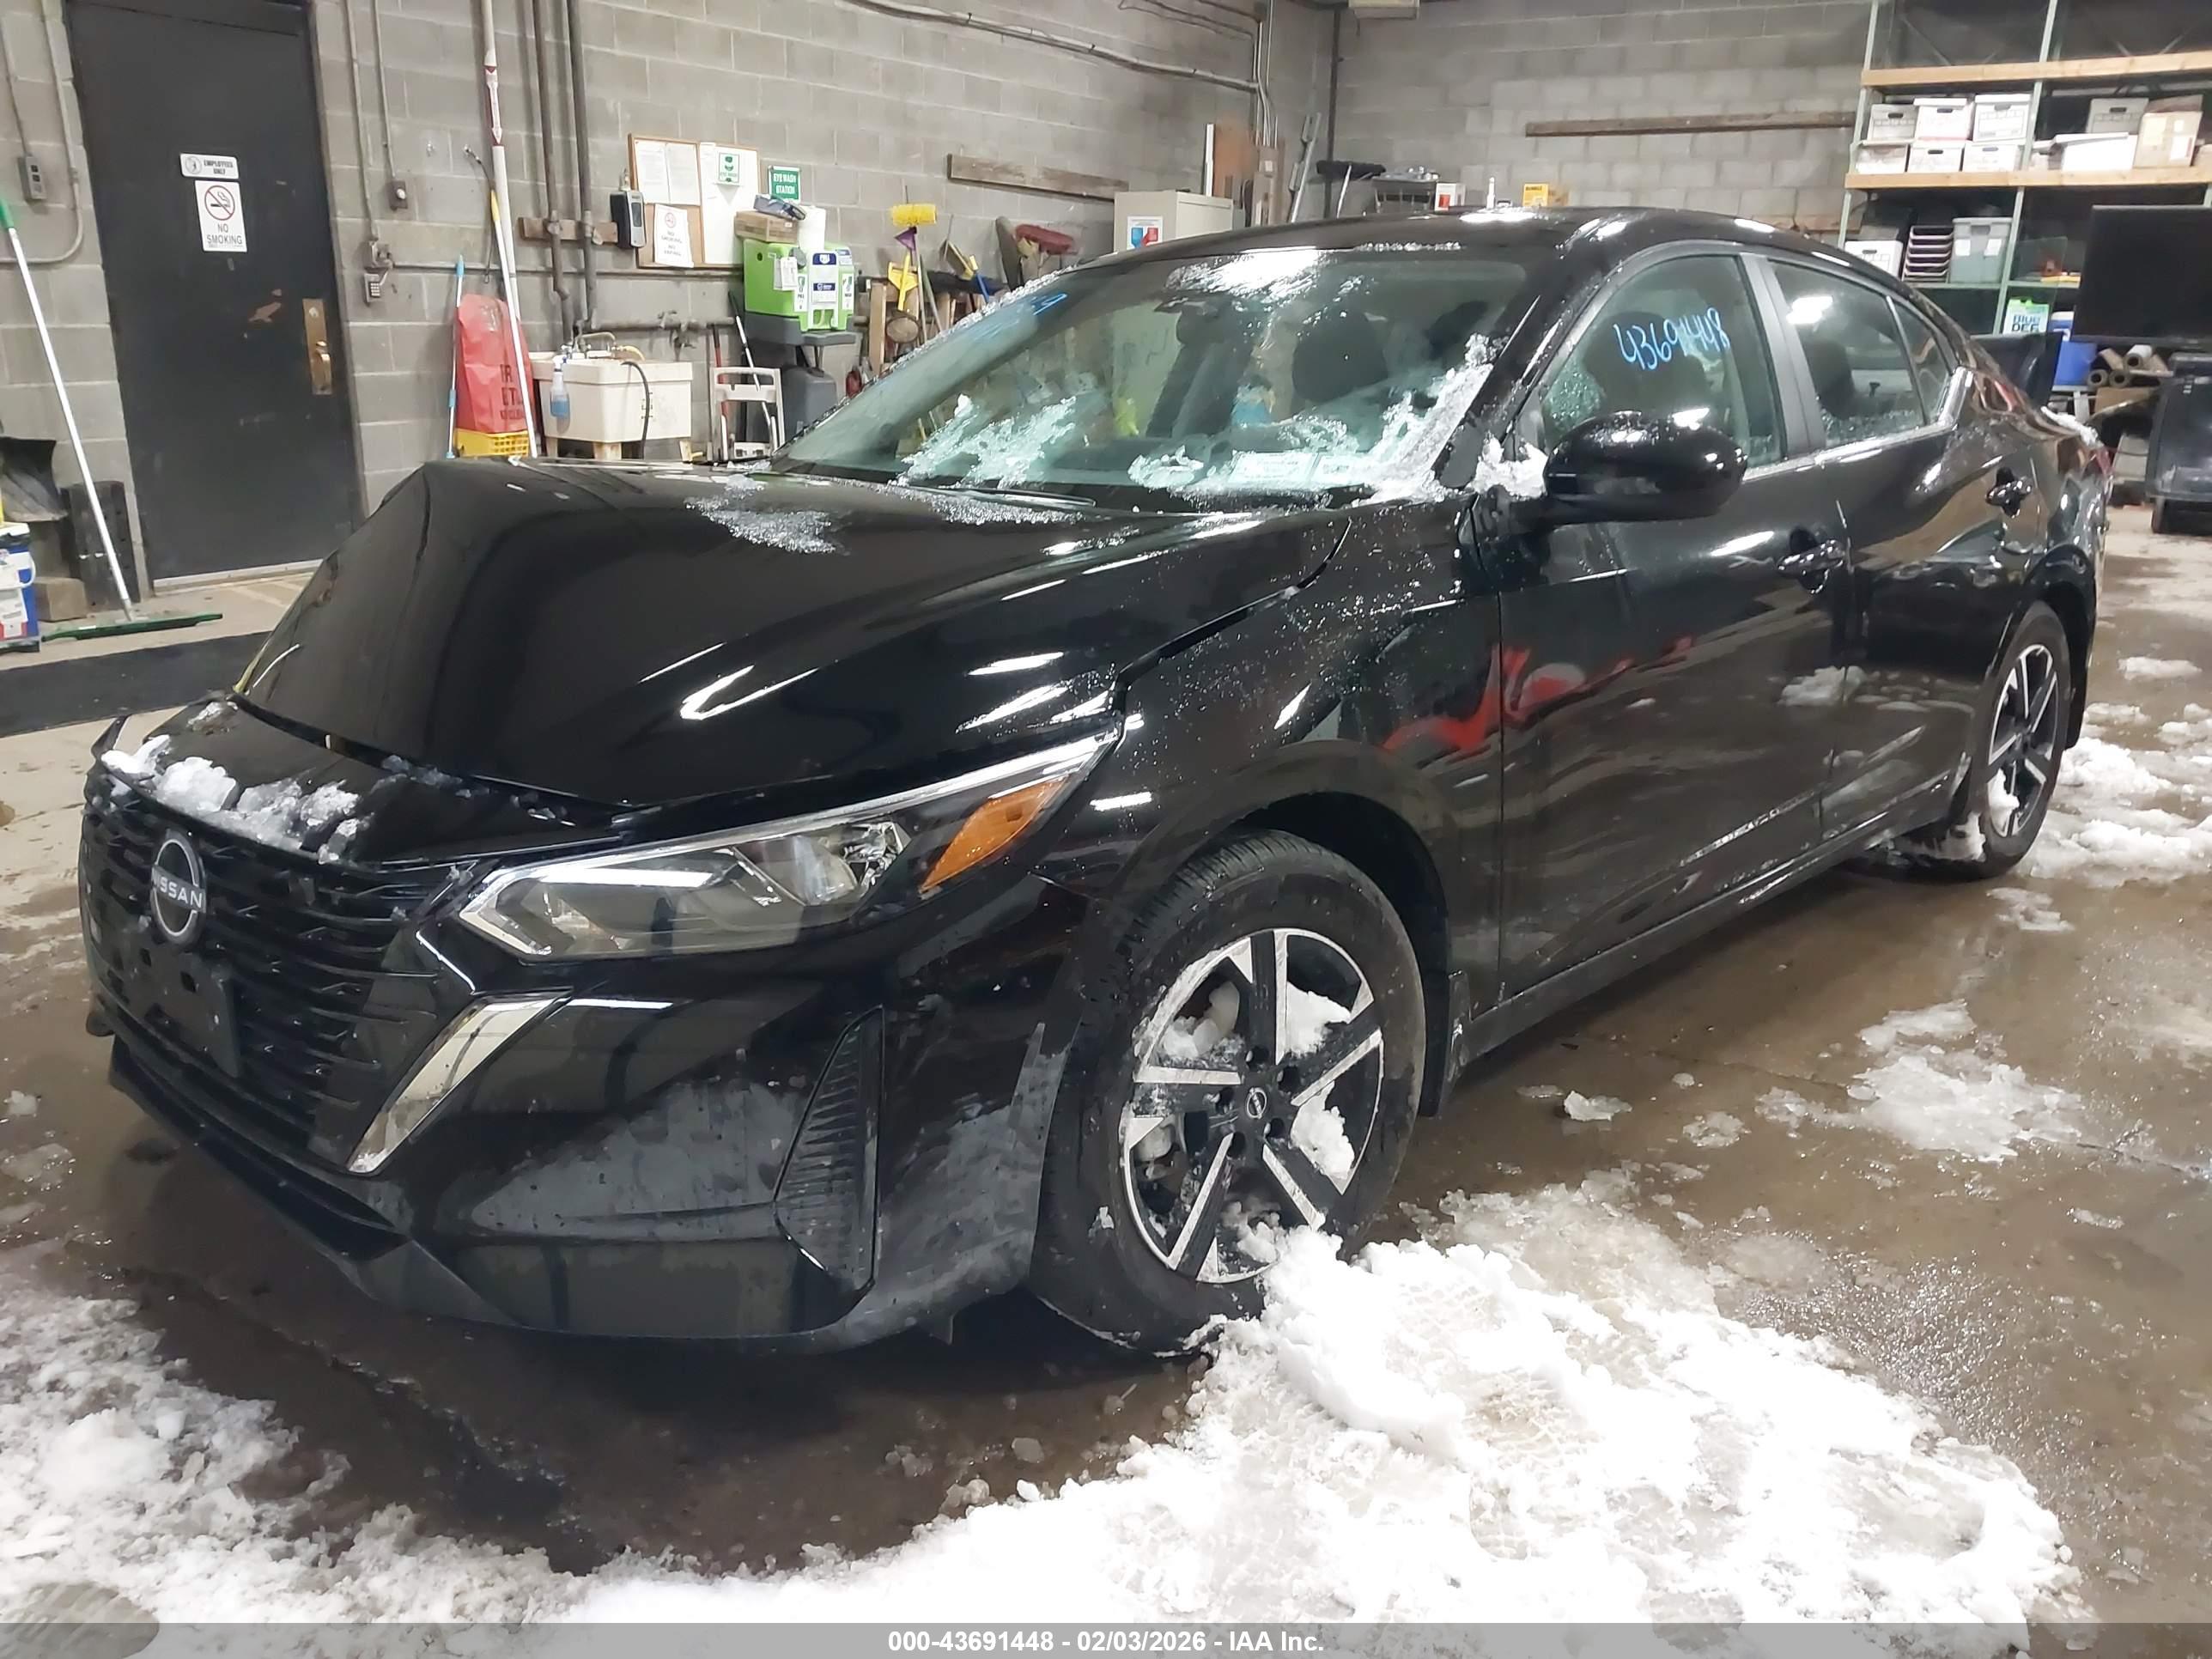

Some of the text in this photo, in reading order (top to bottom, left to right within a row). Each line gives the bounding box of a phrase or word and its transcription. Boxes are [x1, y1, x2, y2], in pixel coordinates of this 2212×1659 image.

[773, 173, 797, 183] EYE WASH
[775, 185, 796, 194] STATION
[217, 223, 229, 233] NO
[206, 234, 243, 245] SMOKING
[151, 867, 203, 908] NISSAN
